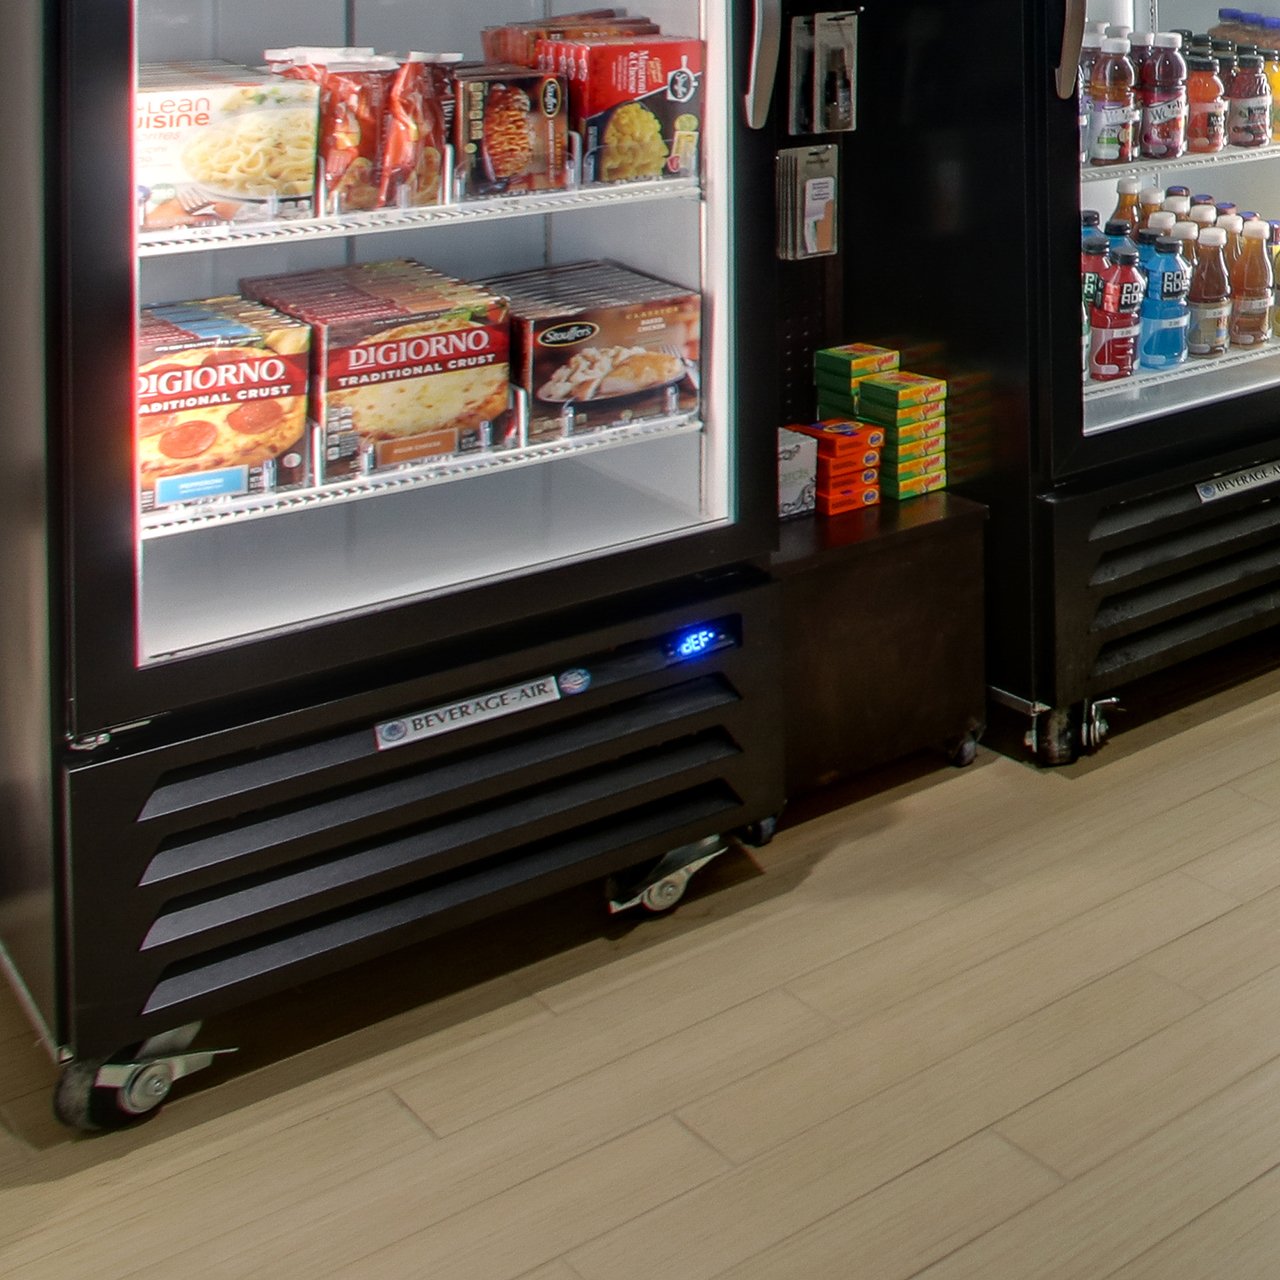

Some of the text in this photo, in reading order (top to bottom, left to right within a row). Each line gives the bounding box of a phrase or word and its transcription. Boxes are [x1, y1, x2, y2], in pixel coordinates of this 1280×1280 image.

[627, 61, 636, 94] Cheese
[636, 49, 649, 94] Macaroni
[348, 329, 490, 370] DIGIORNO
[542, 324, 596, 346] Stouffer's
[338, 353, 496, 388] TRADITIONAL CRUST
[236, 384, 292, 400] CRUST
[411, 681, 551, 733] BEVERAGE-AIR
